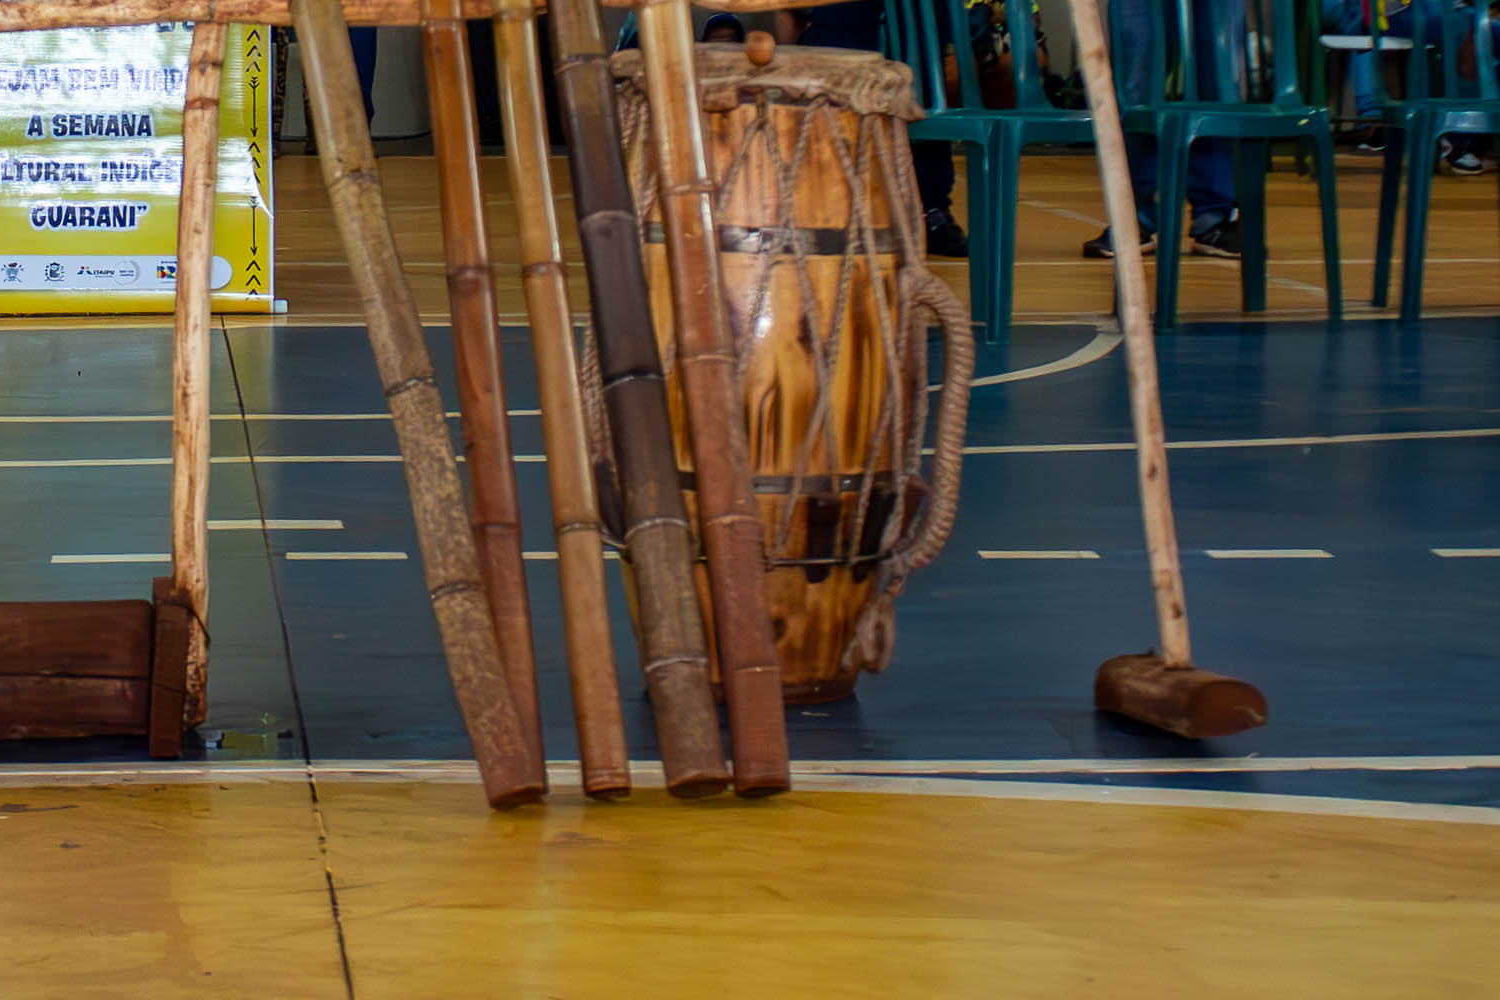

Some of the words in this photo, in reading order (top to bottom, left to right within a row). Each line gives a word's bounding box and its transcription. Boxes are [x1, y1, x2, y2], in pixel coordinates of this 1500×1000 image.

[68, 68, 119, 90] BEM
[27, 115, 44, 136] A
[53, 114, 153, 136] SEMANA
